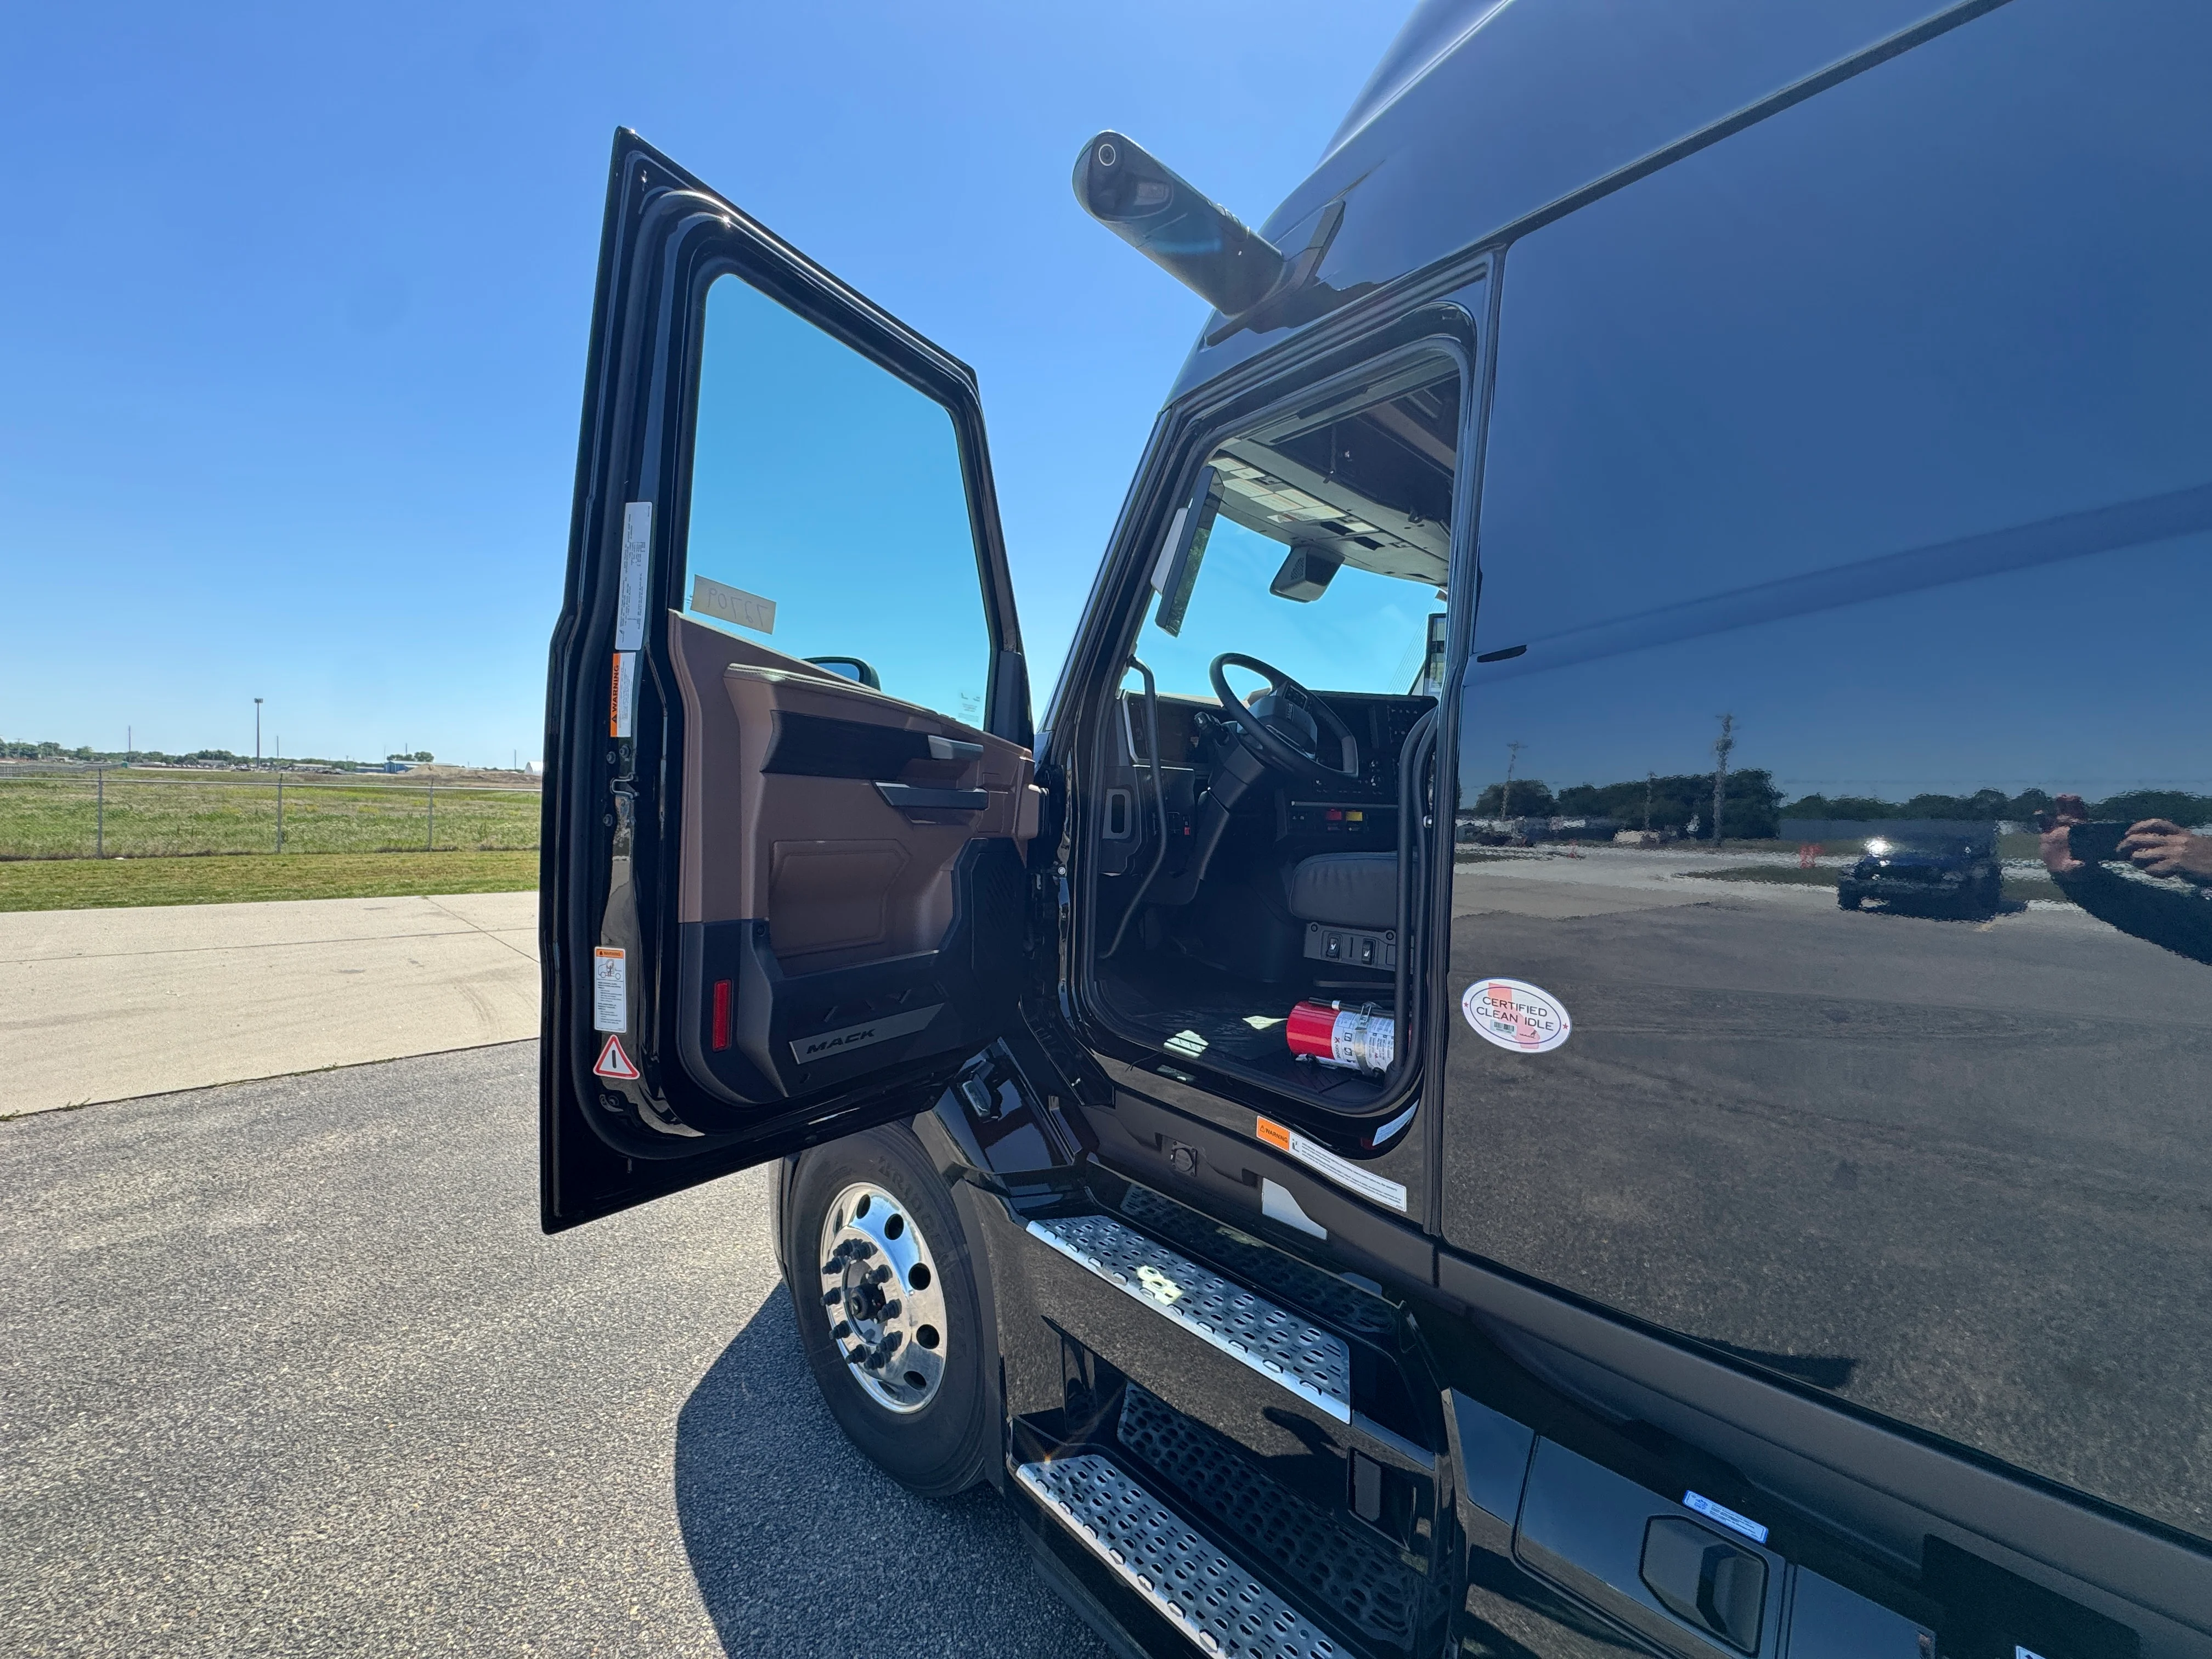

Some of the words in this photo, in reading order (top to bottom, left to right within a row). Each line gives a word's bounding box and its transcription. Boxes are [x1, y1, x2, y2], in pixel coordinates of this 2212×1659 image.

[1482, 996, 1548, 1017] CERTIFIED
[1476, 1007, 1518, 1023] CLEAN
[1525, 1017, 1554, 1031] IDLE
[806, 1029, 876, 1054] MACK
[1265, 1128, 1288, 1143] WARNING
